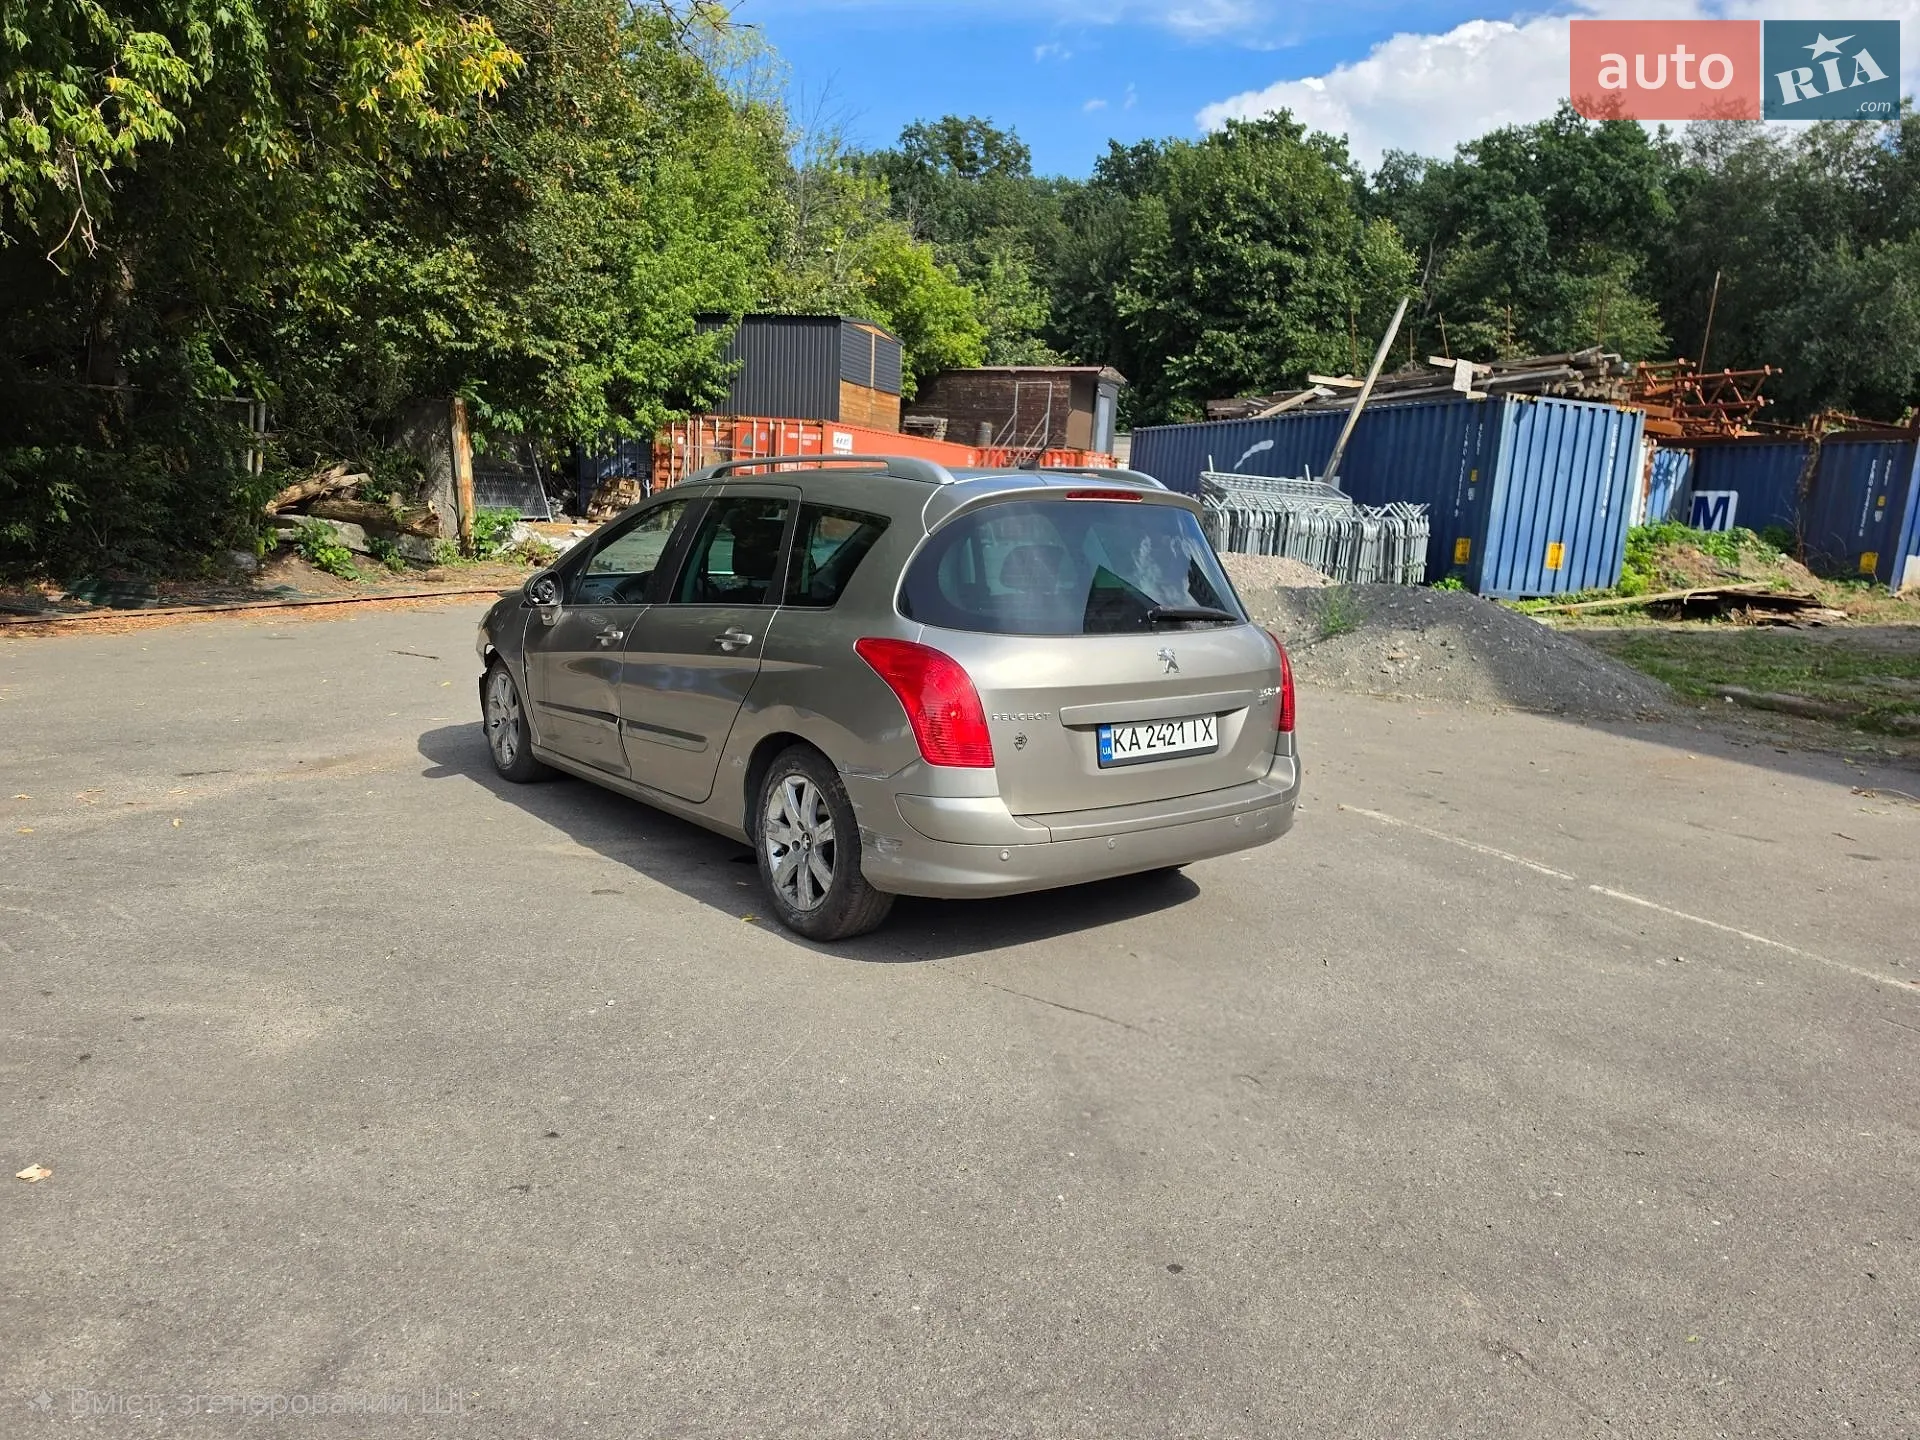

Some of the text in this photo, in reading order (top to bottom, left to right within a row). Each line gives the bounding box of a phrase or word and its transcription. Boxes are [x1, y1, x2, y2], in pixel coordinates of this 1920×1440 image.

[991, 712, 1053, 722] PEUGEOT
[1113, 727, 1141, 753] KA
[1145, 721, 1186, 749] 2421
[1102, 746, 1112, 756] UA
